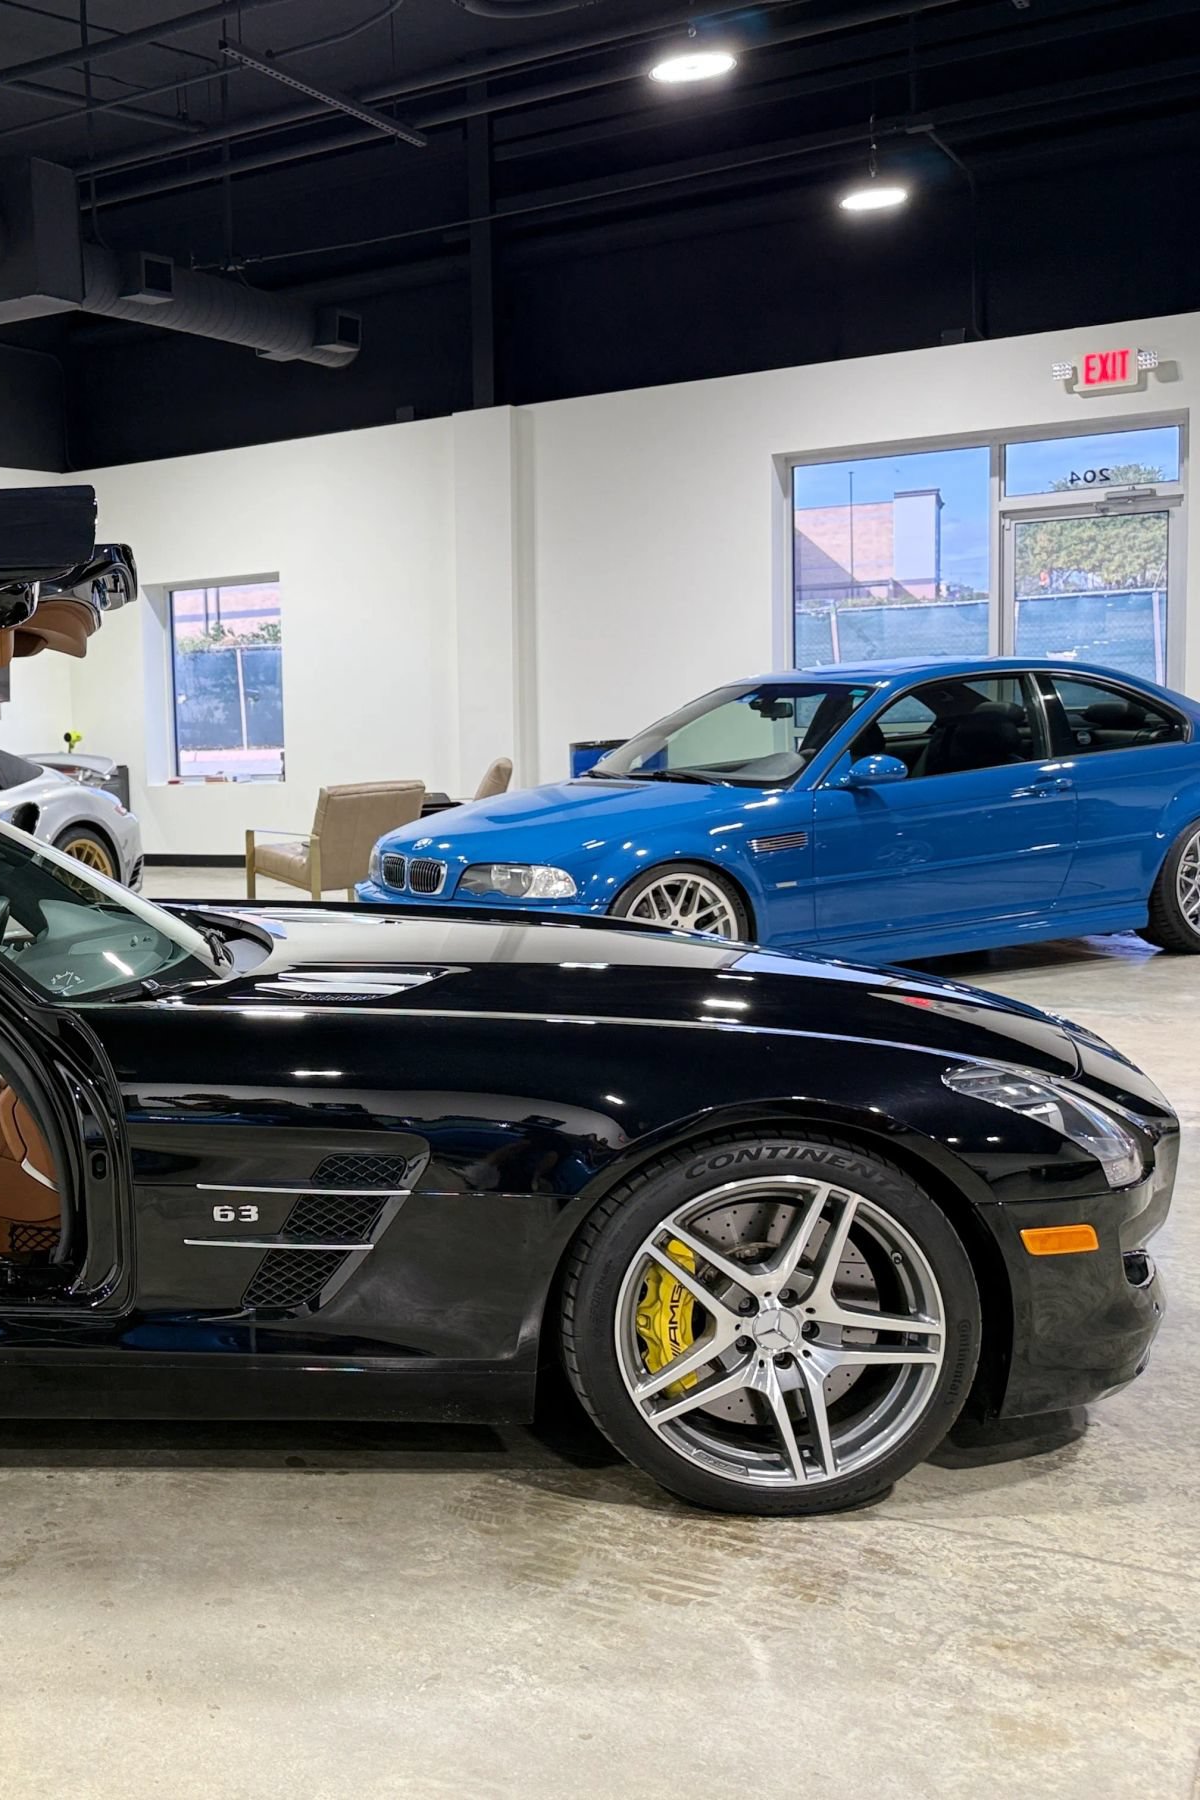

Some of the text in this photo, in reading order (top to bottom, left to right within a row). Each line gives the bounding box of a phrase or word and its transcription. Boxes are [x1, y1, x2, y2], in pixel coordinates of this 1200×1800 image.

[1084, 350, 1130, 385] EXIT
[213, 1205, 259, 1222] 63
[667, 1283, 686, 1346] AMG
